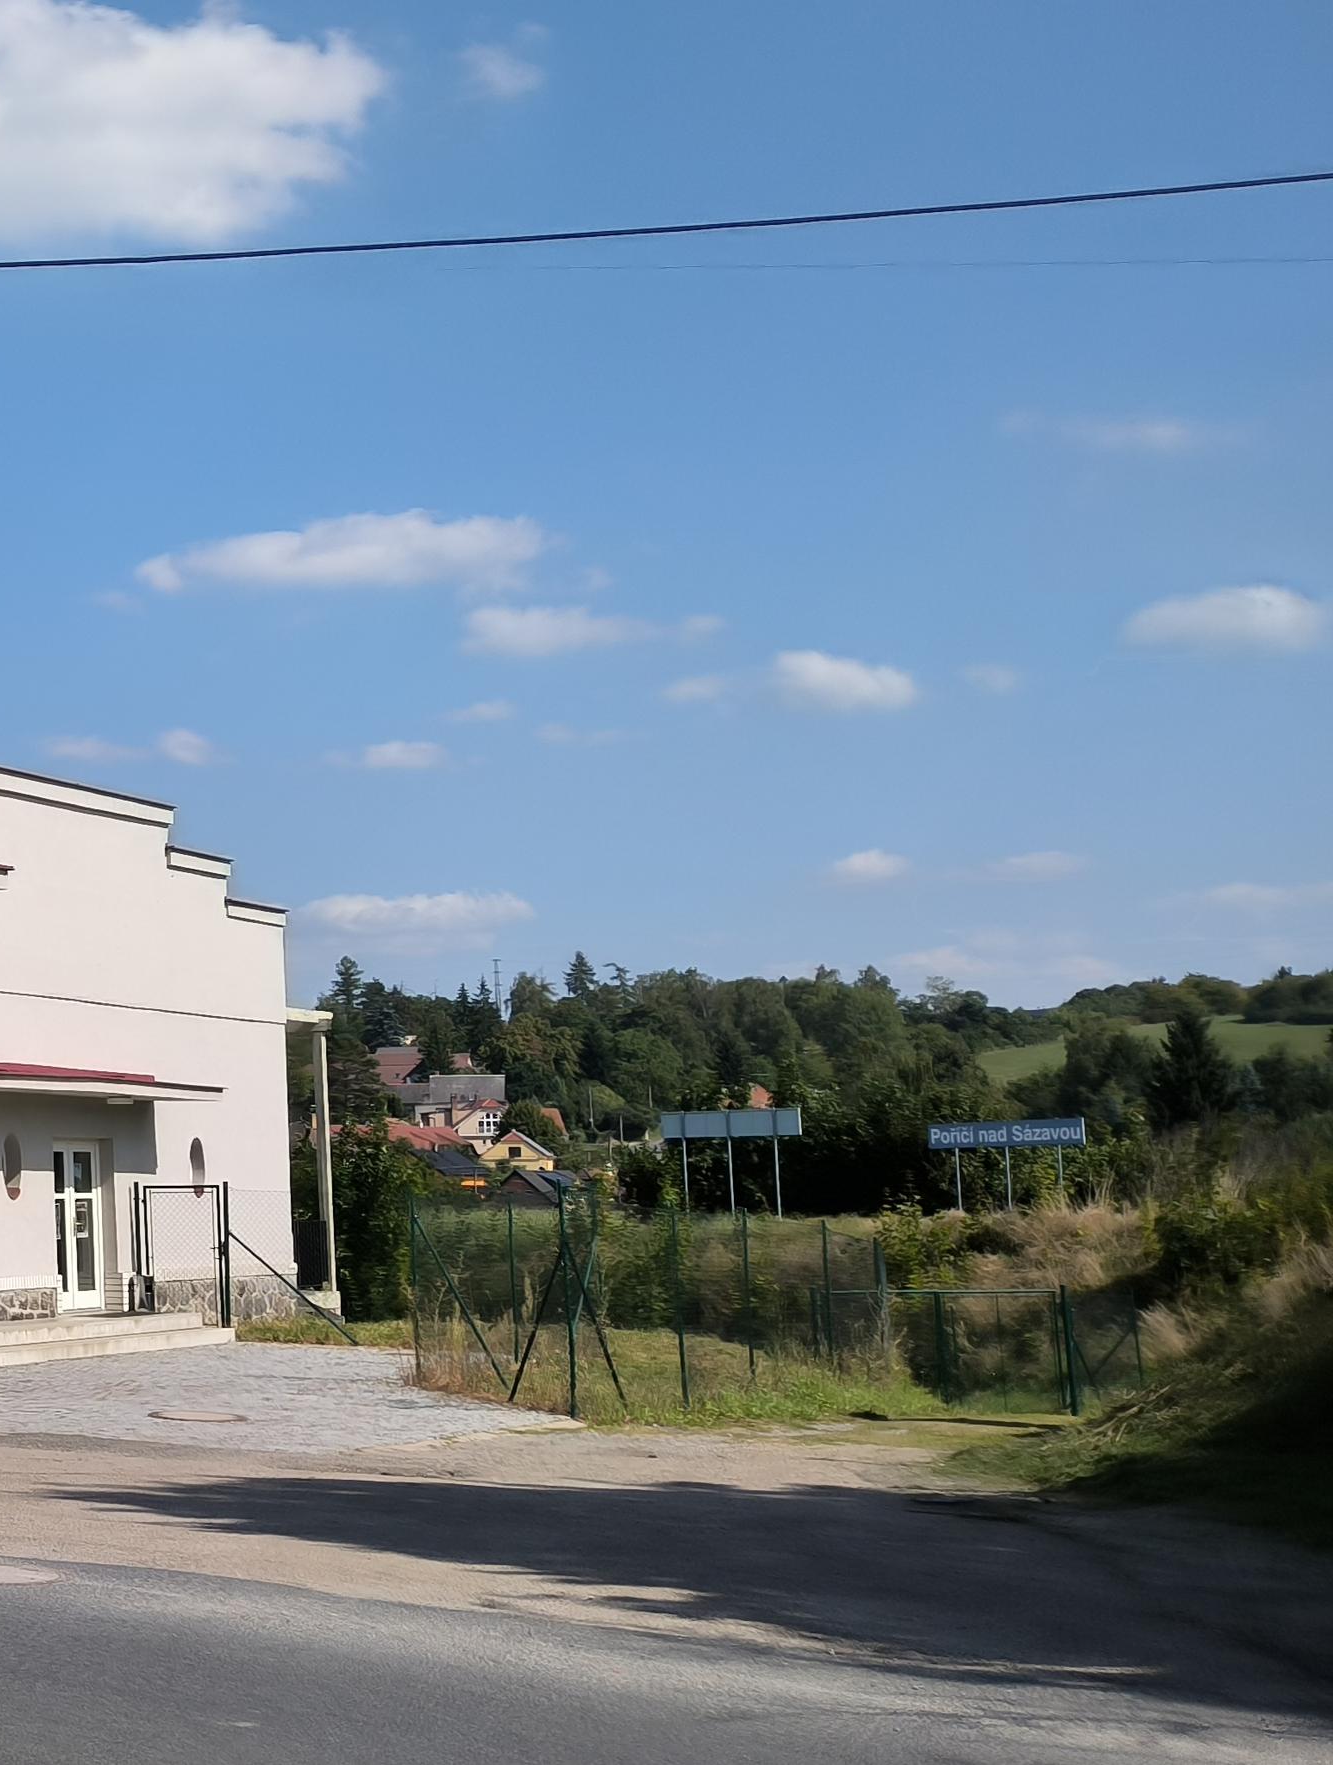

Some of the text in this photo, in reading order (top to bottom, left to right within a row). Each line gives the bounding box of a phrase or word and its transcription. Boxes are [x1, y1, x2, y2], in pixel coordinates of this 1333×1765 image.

[930, 1124, 1081, 1144] Poříčí nad Sázavou
